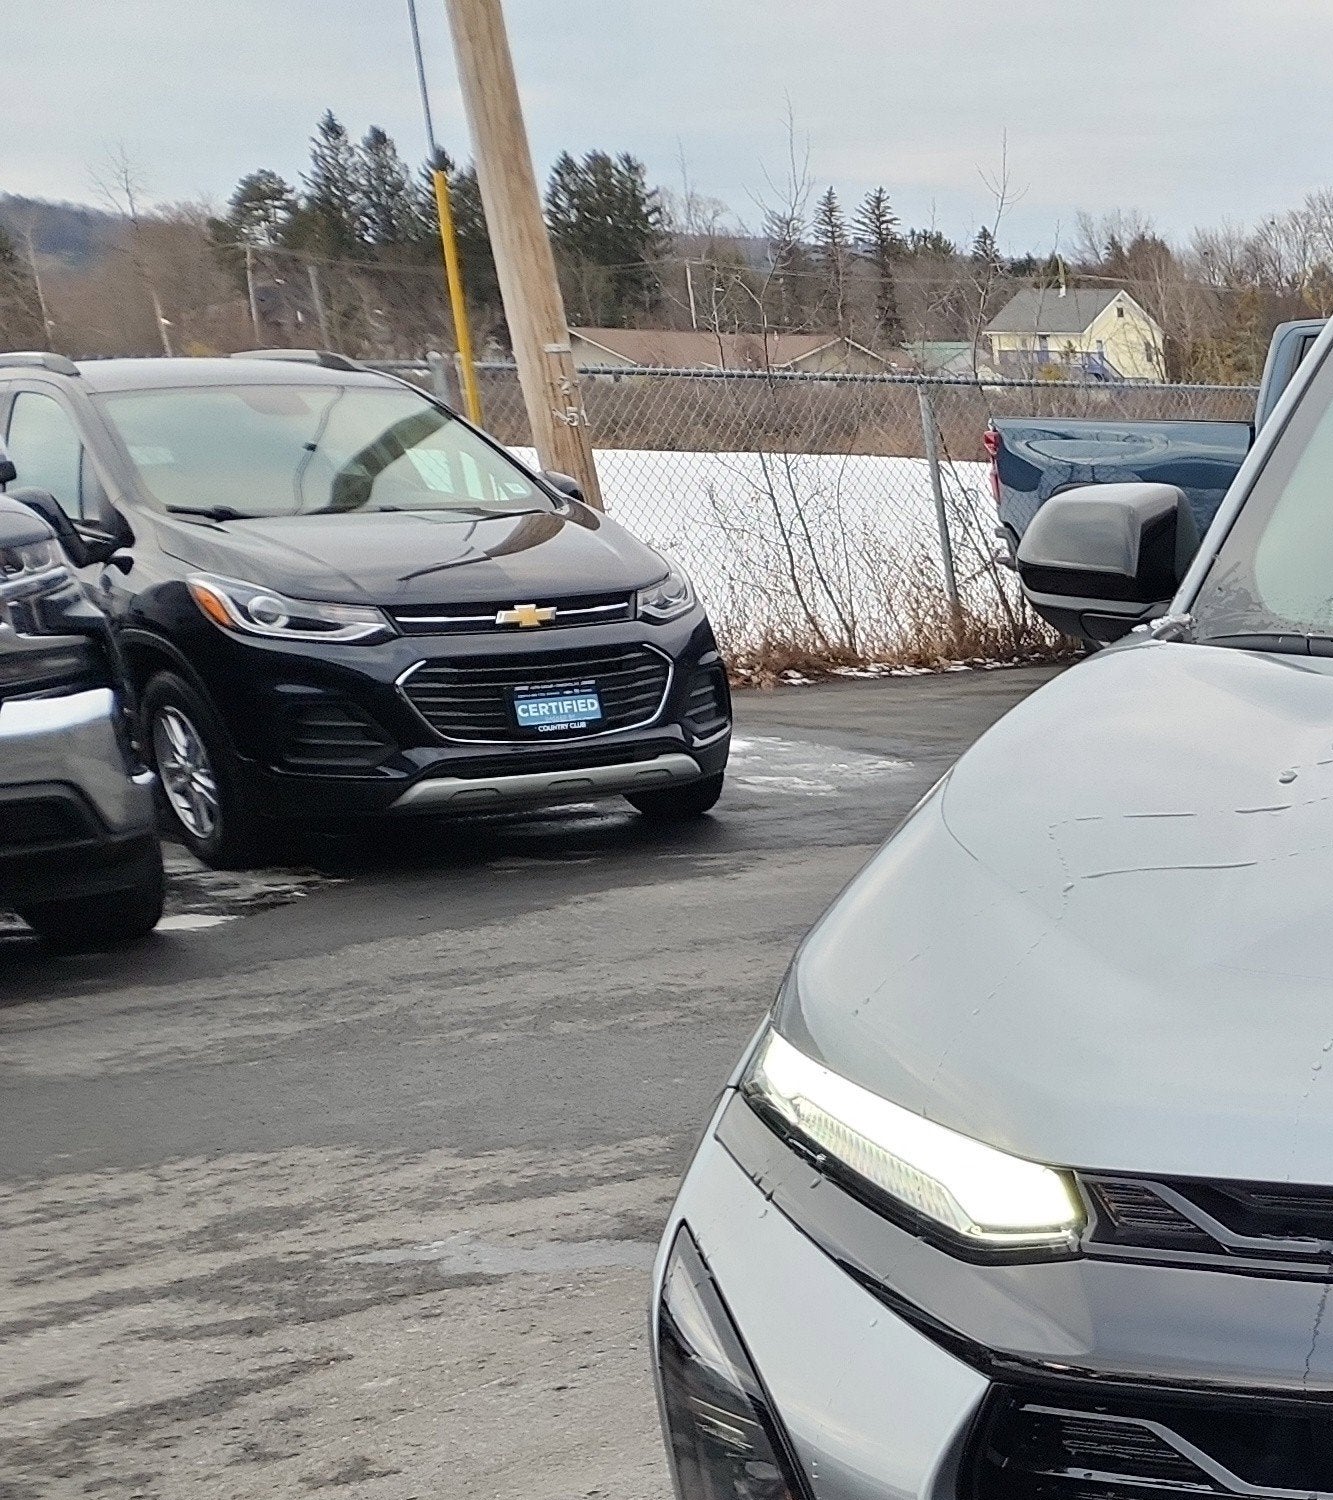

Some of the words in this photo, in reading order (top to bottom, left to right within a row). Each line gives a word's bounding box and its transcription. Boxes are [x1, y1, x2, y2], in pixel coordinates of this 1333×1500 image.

[517, 698, 598, 718] CERTIFIED
[538, 722, 568, 732] COUNTRY
[569, 721, 587, 729] CLUB
